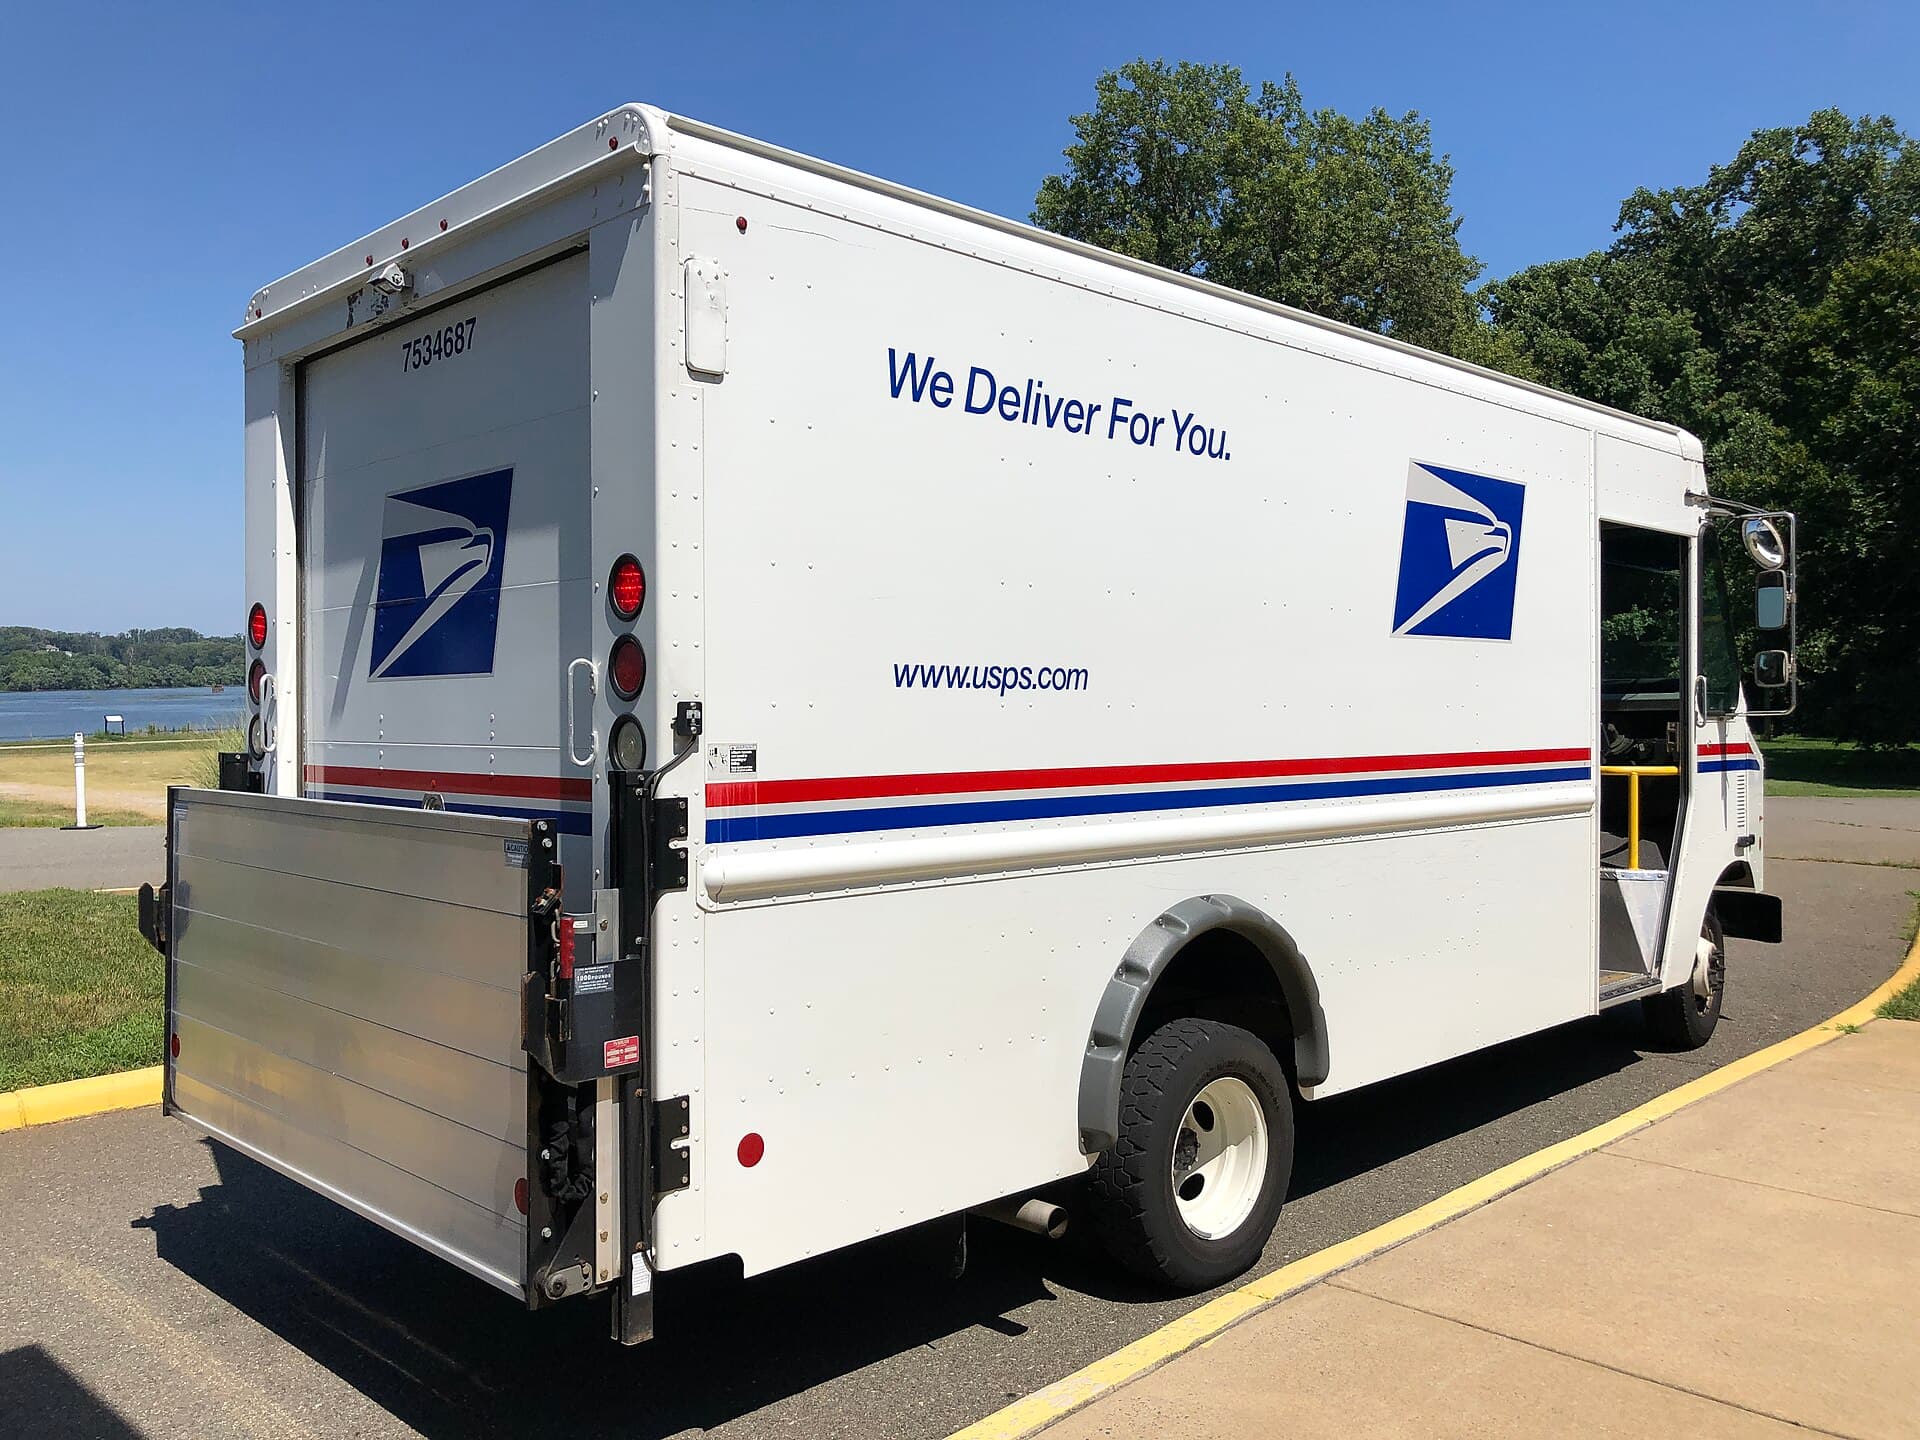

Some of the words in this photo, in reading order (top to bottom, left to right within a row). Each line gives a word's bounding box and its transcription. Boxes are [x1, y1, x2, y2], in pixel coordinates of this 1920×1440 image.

[402, 316, 477, 372] 7534687
[888, 348, 954, 409] We
[964, 366, 1102, 434] Deliver
[1107, 397, 1165, 447] For
[1172, 409, 1231, 461] You.
[893, 664, 1089, 697] www.usps.com
